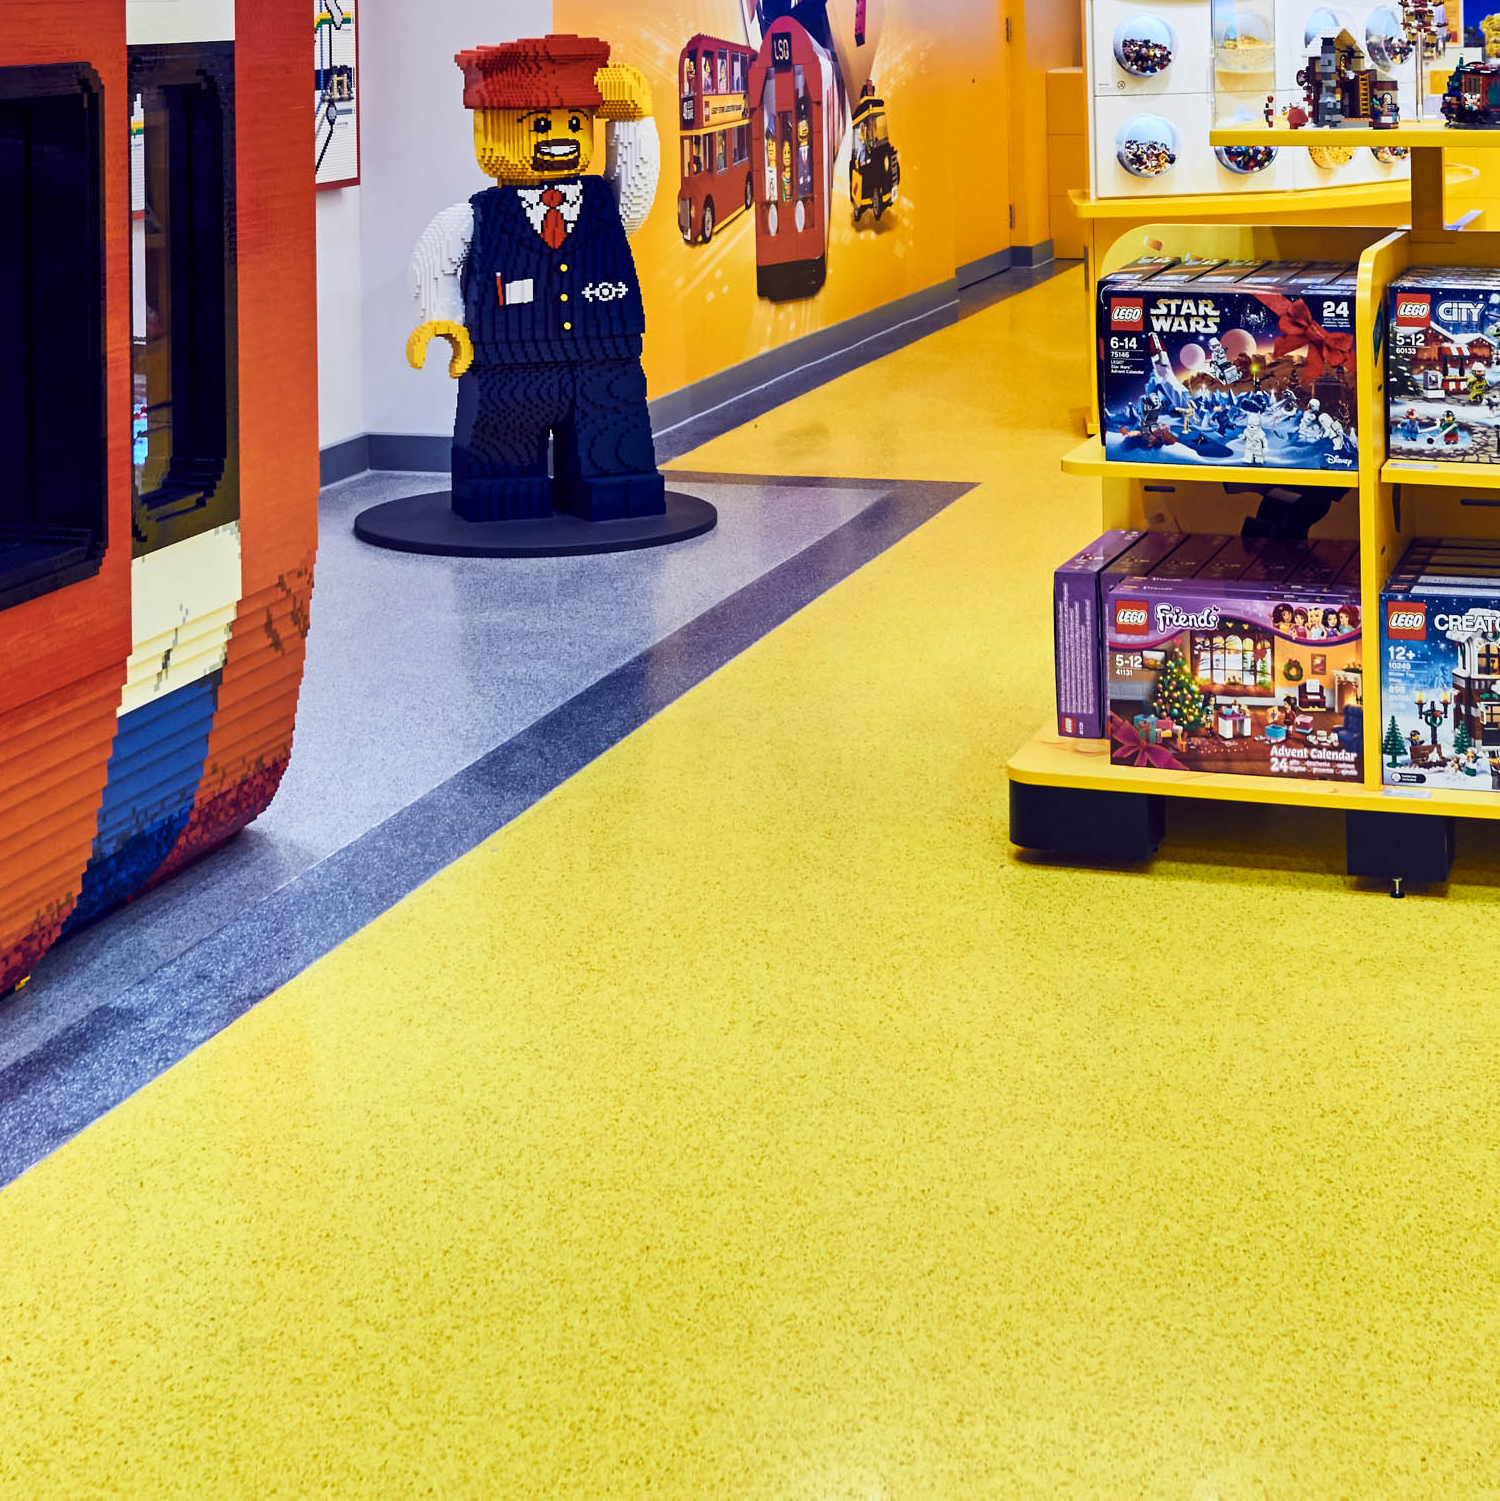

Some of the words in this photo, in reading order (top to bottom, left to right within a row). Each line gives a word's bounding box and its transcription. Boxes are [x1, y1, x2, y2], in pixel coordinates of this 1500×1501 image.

[1112, 306, 1143, 322] LEGO
[1149, 298, 1220, 316] STAR
[1322, 301, 1350, 317] 24
[1397, 302, 1429, 318] LEGO
[1150, 316, 1220, 334] WARS
[1110, 337, 1138, 349] 6-14
[1396, 333, 1425, 346] 5-12
[1324, 453, 1353, 467] Disney
[1116, 609, 1148, 625] LEGO
[1389, 612, 1425, 630] LEGO
[1388, 646, 1416, 660] 12+
[1116, 655, 1142, 668] 5-12
[1270, 745, 1308, 758] Advent
[1310, 748, 1358, 762] Calendar
[1270, 758, 1288, 773] 24
